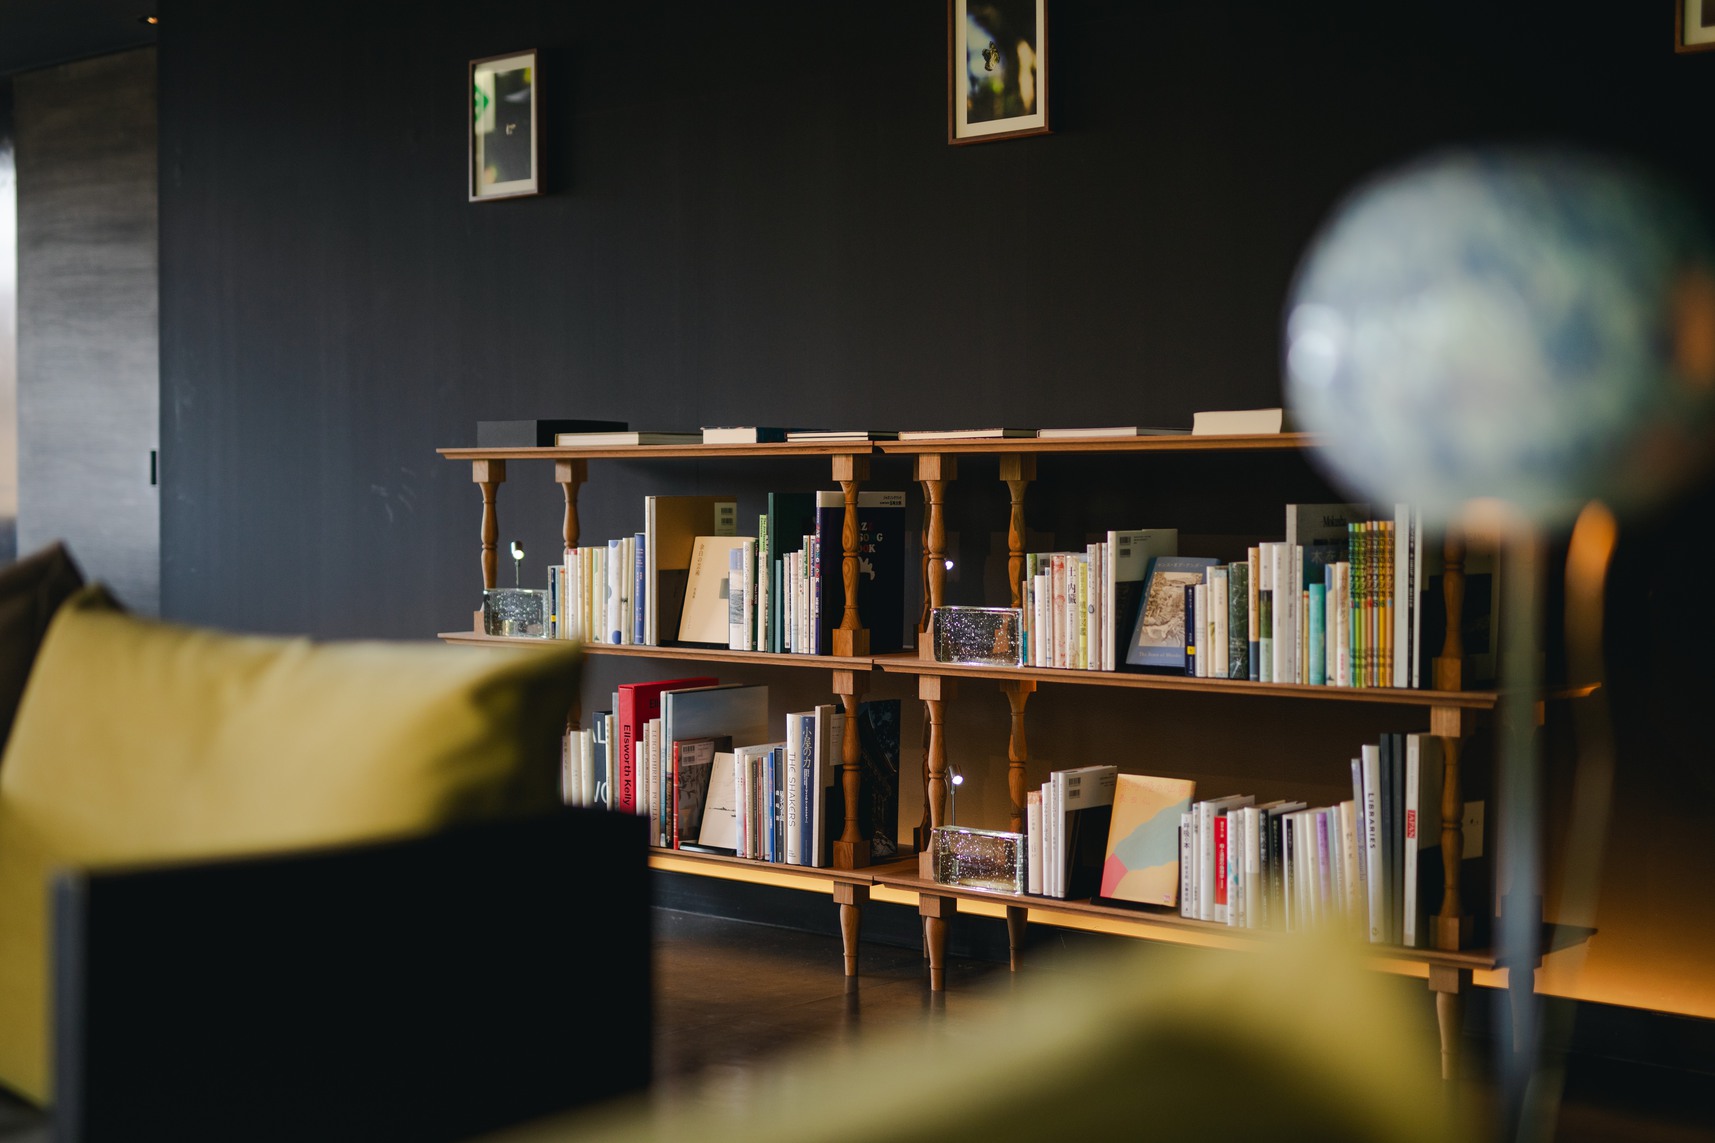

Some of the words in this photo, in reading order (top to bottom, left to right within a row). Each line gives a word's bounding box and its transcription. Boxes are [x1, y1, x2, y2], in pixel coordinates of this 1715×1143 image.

[623, 724, 632, 777] Ellsworth
[788, 752, 796, 773] THE
[803, 726, 812, 769] 小屋の力
[624, 779, 632, 807] Kelly
[788, 778, 796, 828] SHAKERS
[1368, 792, 1376, 850] LIBRARIES
[1407, 810, 1416, 839] JAPAN
